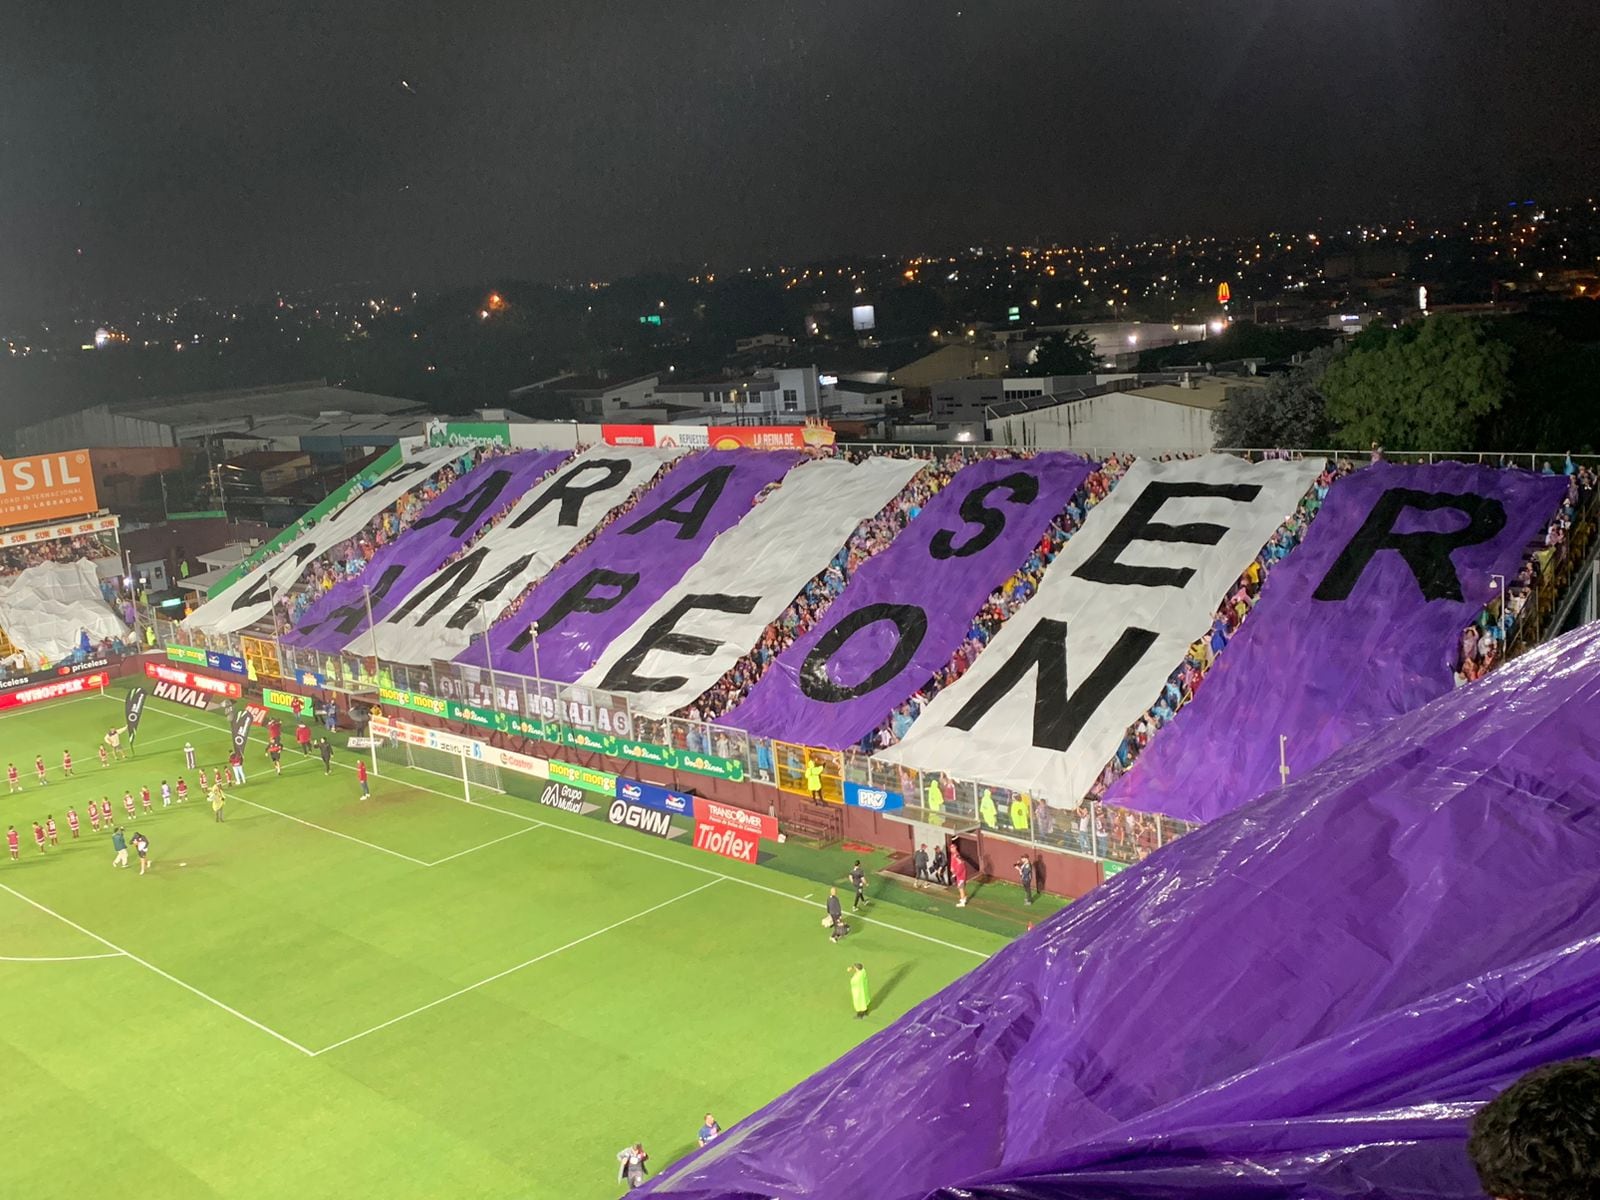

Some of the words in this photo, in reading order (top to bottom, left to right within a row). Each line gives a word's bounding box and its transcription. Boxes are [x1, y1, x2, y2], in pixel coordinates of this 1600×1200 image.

[785, 432, 794, 446] DE
[929, 472, 1509, 602] SER
[72, 659, 108, 672] priceless
[153, 682, 207, 708] HAVAL
[380, 688, 409, 705] monge
[413, 696, 445, 713] monge
[550, 763, 579, 780] monge
[583, 772, 615, 791] monge
[561, 785, 582, 801] Grupo
[559, 799, 582, 813] Mutual
[625, 805, 670, 835] GWM
[697, 823, 754, 861] Tioflex
